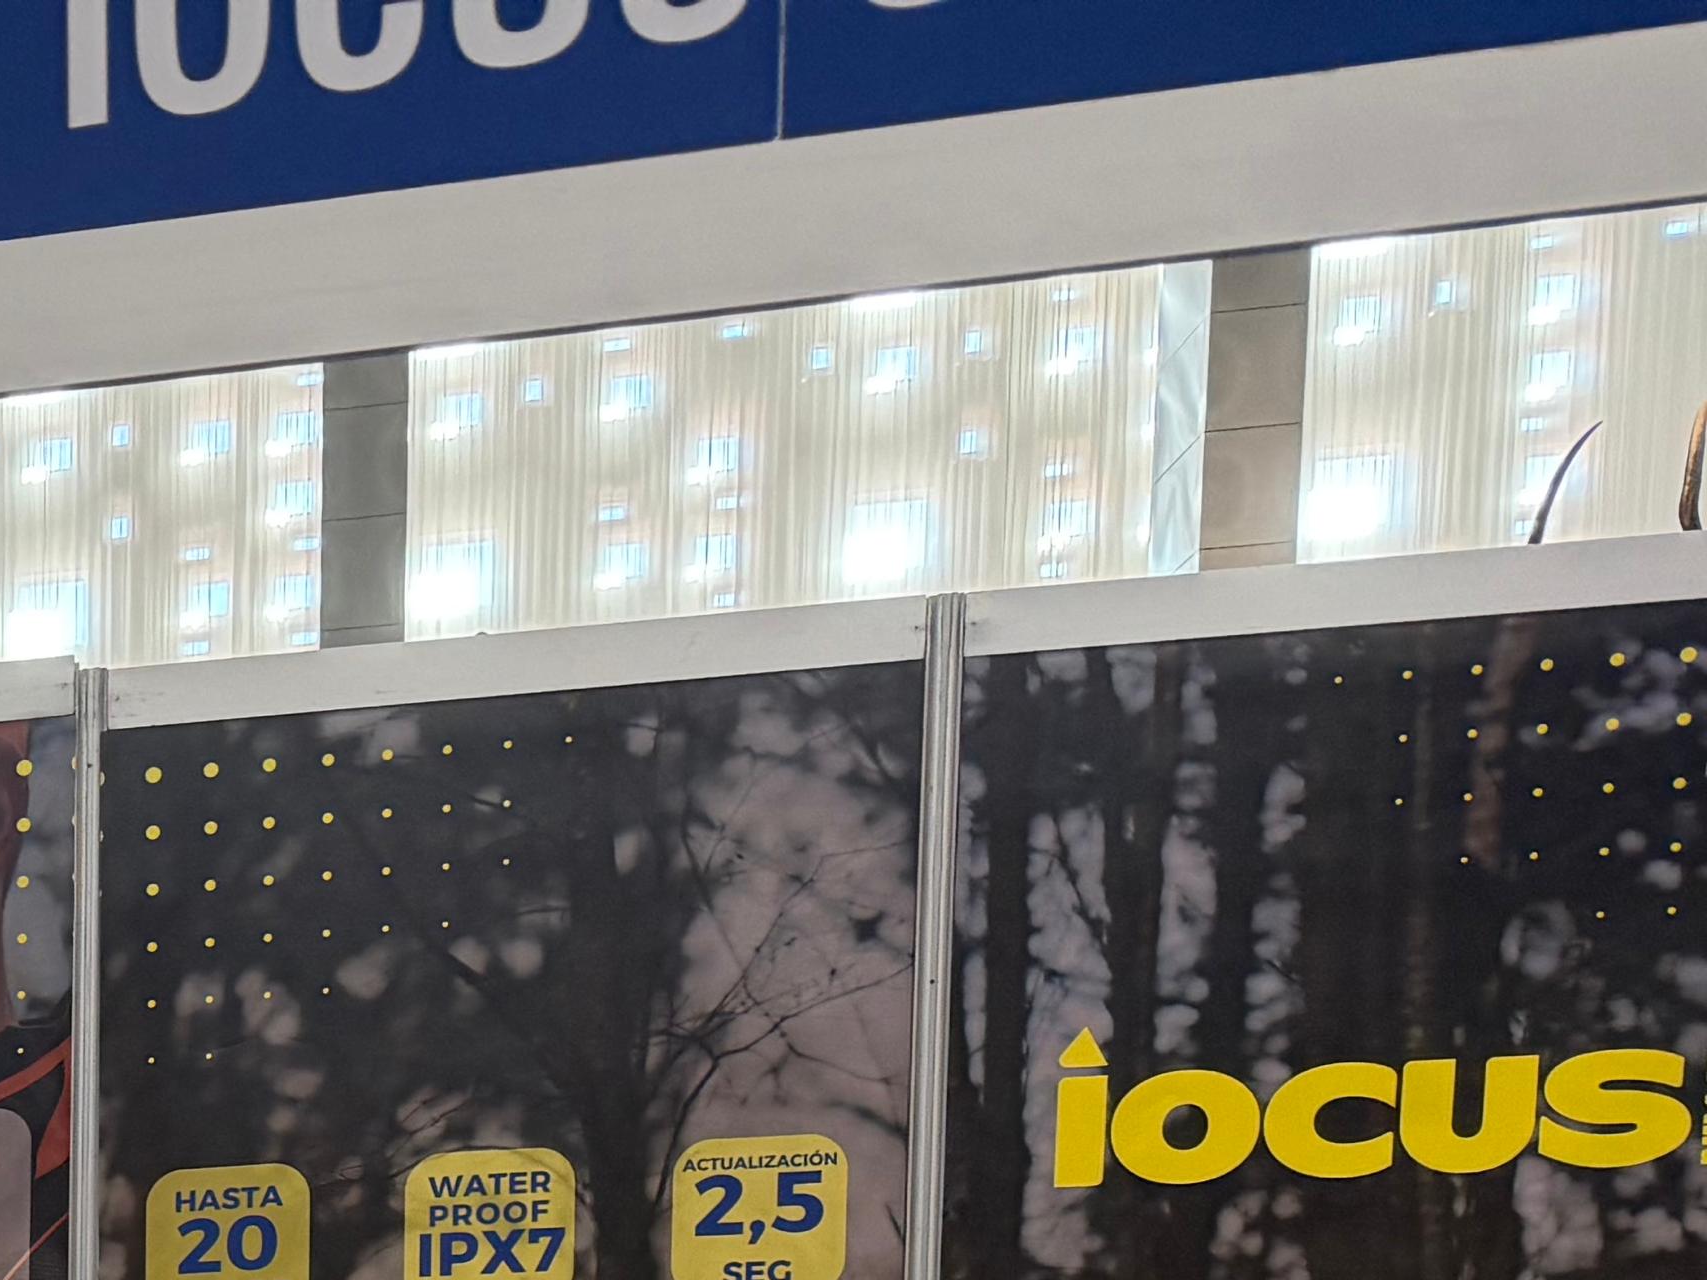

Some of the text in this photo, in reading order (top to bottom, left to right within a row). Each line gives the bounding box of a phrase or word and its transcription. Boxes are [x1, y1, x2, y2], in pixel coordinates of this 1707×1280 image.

[682, 1150, 839, 1174] ACTUALIZACIÓN
[174, 1184, 284, 1214] HASTA
[428, 1170, 552, 1199] WATER
[428, 1198, 551, 1228] PROOF
[693, 1168, 825, 1247] 2,5
[177, 1214, 279, 1276] 20
[418, 1226, 567, 1279] IPX7
